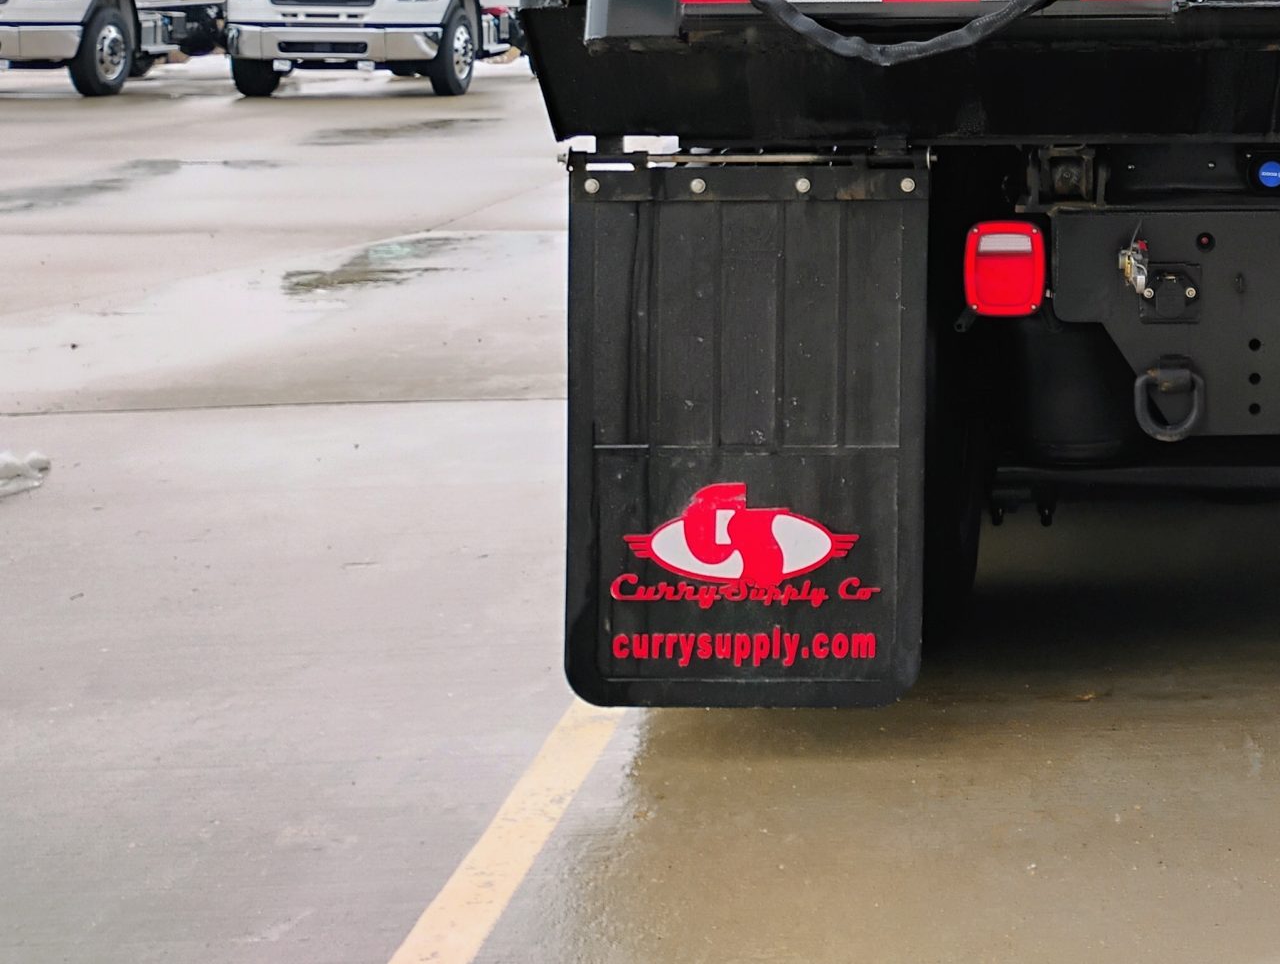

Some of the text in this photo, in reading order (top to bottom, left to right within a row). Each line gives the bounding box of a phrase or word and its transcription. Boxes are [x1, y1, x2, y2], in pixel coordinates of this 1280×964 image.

[610, 573, 881, 609] Curry Supply Co
[612, 624, 877, 667] currysupply.com
